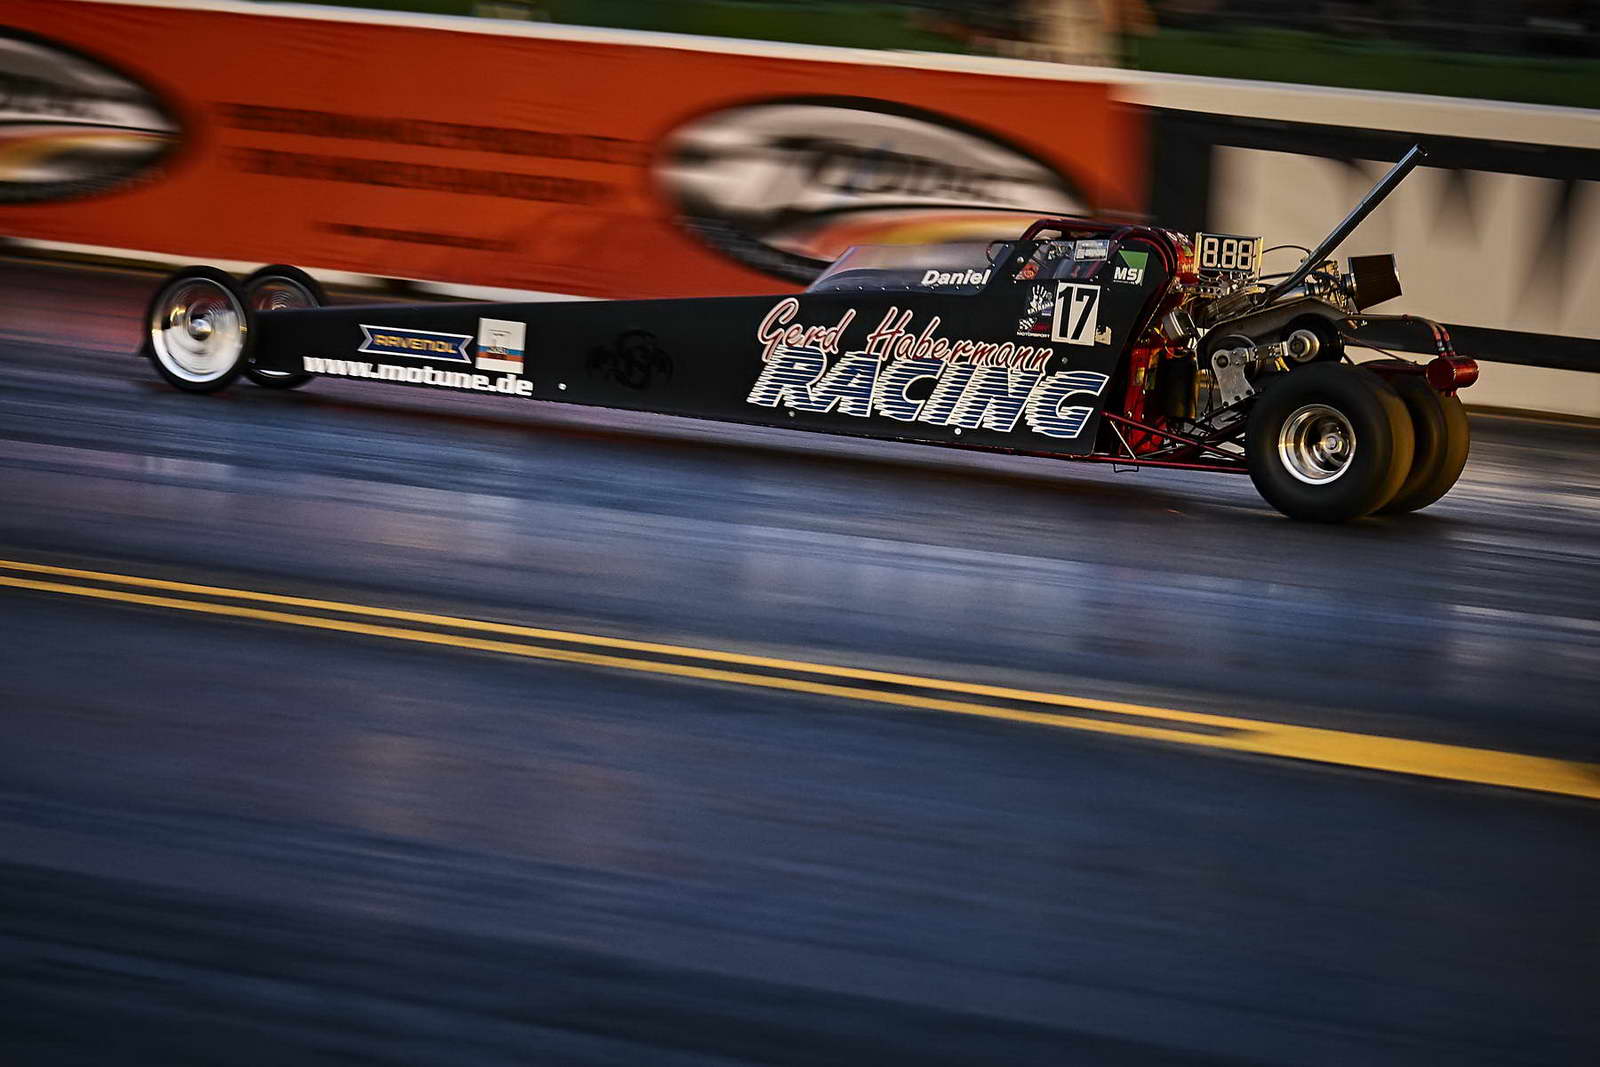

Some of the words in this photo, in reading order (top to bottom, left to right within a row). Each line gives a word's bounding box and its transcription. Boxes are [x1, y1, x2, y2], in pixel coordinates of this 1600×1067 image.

[1202, 237, 1254, 270] 8.88
[921, 269, 991, 286] Daniel
[1057, 286, 1099, 340] 17
[373, 334, 457, 354] RAVENOL
[757, 297, 857, 361] Gerd
[866, 306, 1054, 374] Habermann
[303, 356, 534, 396] www.motune.de
[746, 344, 1110, 438] RACING
